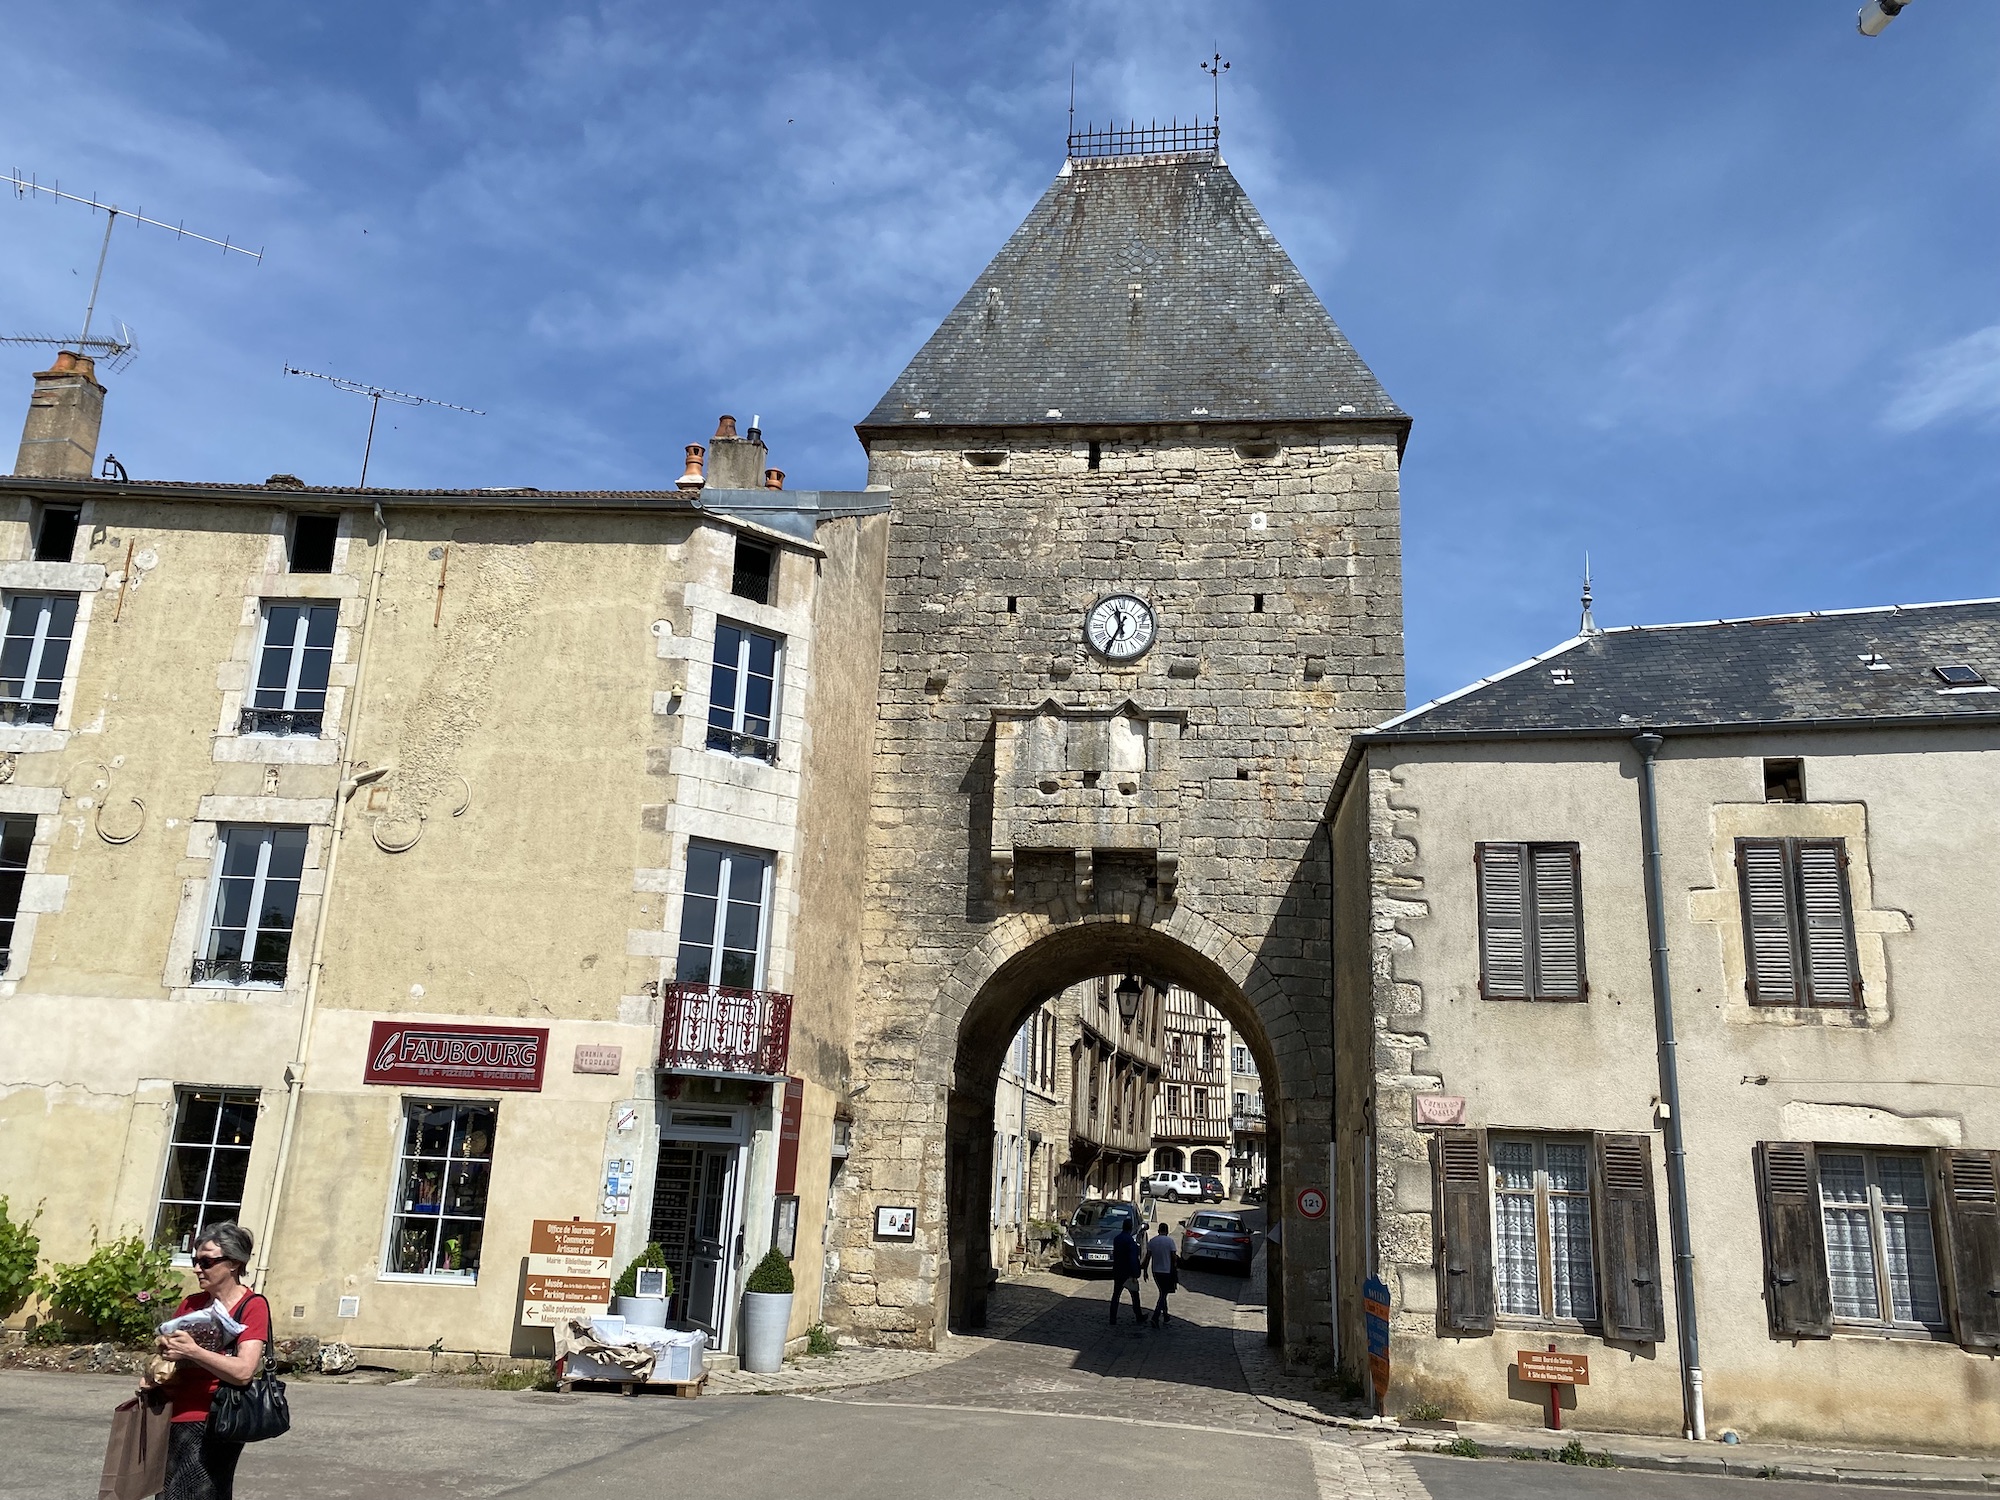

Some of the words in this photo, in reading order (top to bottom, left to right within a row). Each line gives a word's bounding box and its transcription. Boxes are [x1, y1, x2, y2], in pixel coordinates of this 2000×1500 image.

[373, 1032, 401, 1071] le
[399, 1031, 540, 1067] FAUBOURG
[580, 1050, 603, 1058] CHEMIN
[418, 1069, 434, 1077] BAR
[442, 1070, 475, 1079] PIZZERIA
[518, 1073, 535, 1081] FINE
[1423, 1098, 1447, 1109] CHEMIN
[547, 1223, 563, 1235] Office
[563, 1225, 571, 1234] de
[571, 1225, 596, 1236] Tourisme
[563, 1235, 595, 1245] Commerces
[556, 1244, 579, 1254] Artisans
[580, 1245, 594, 1255] d'art
[546, 1256, 561, 1265] Mairie
[567, 1266, 591, 1275] Pharmacie
[545, 1278, 563, 1289] Musée
[543, 1289, 565, 1301] Parking
[541, 1303, 555, 1313] Salle
[556, 1304, 586, 1315] polyvalente
[1523, 1362, 1545, 1370] Promenade
